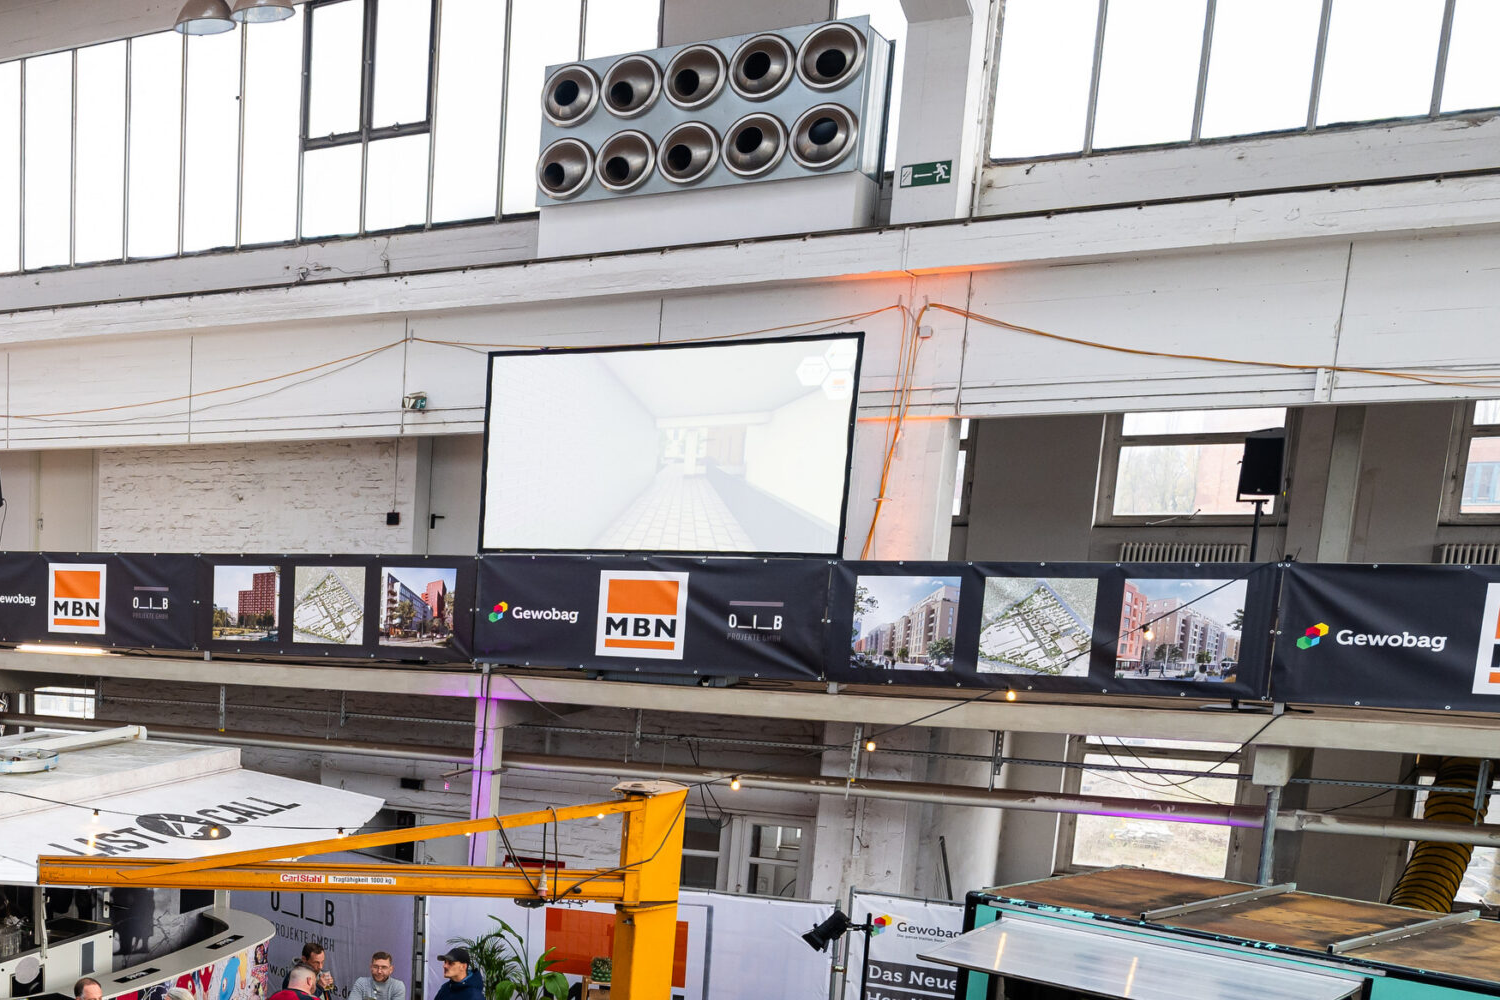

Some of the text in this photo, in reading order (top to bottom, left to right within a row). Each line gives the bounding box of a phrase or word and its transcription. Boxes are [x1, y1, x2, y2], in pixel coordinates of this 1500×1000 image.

[53, 600, 99, 618] MBN
[512, 606, 579, 623] Gewobag
[605, 616, 676, 638] MBN
[727, 633, 759, 642] PROJEKTE
[1336, 629, 1448, 652] Gewobag
[48, 796, 302, 856] LAST CALL
[333, 876, 368, 884] Tragfähigkeit
[311, 934, 335, 952] GMBH
[868, 965, 956, 991] Das Neue
